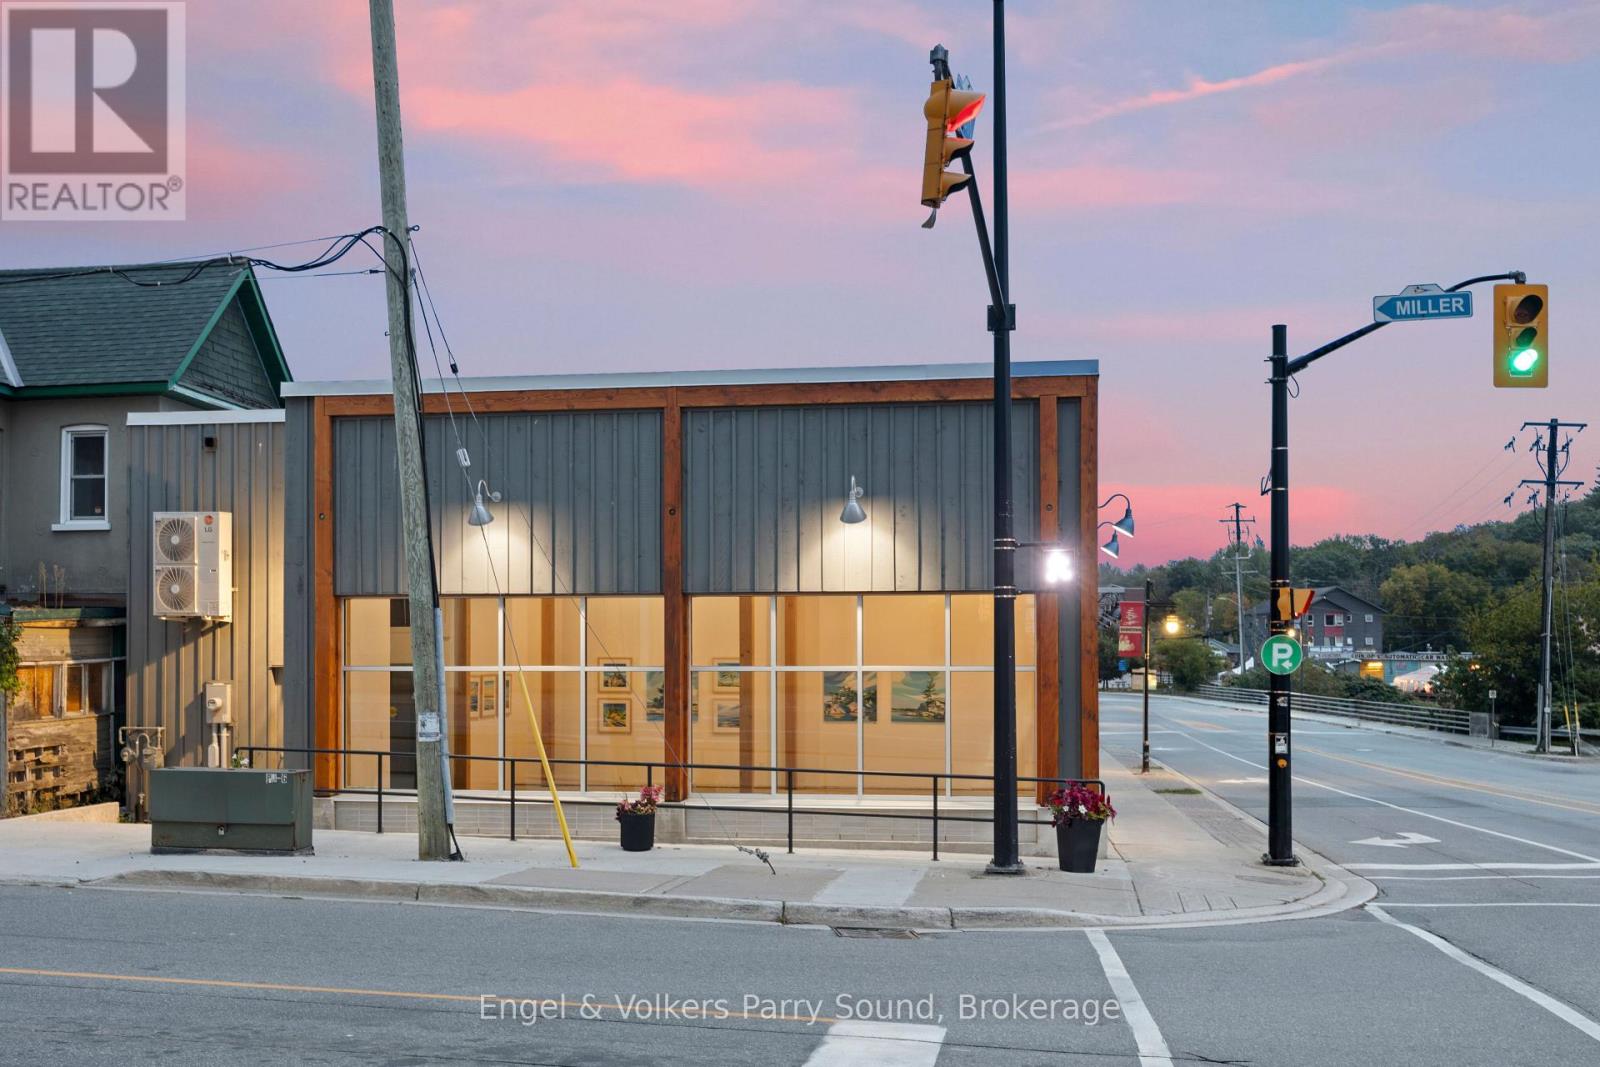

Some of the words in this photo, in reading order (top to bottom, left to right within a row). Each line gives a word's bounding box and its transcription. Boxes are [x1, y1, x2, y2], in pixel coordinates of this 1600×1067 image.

[1395, 297, 1465, 316] MILLER
[1271, 642, 1294, 668] P
[1384, 653, 1418, 661] AUTOMATIC
